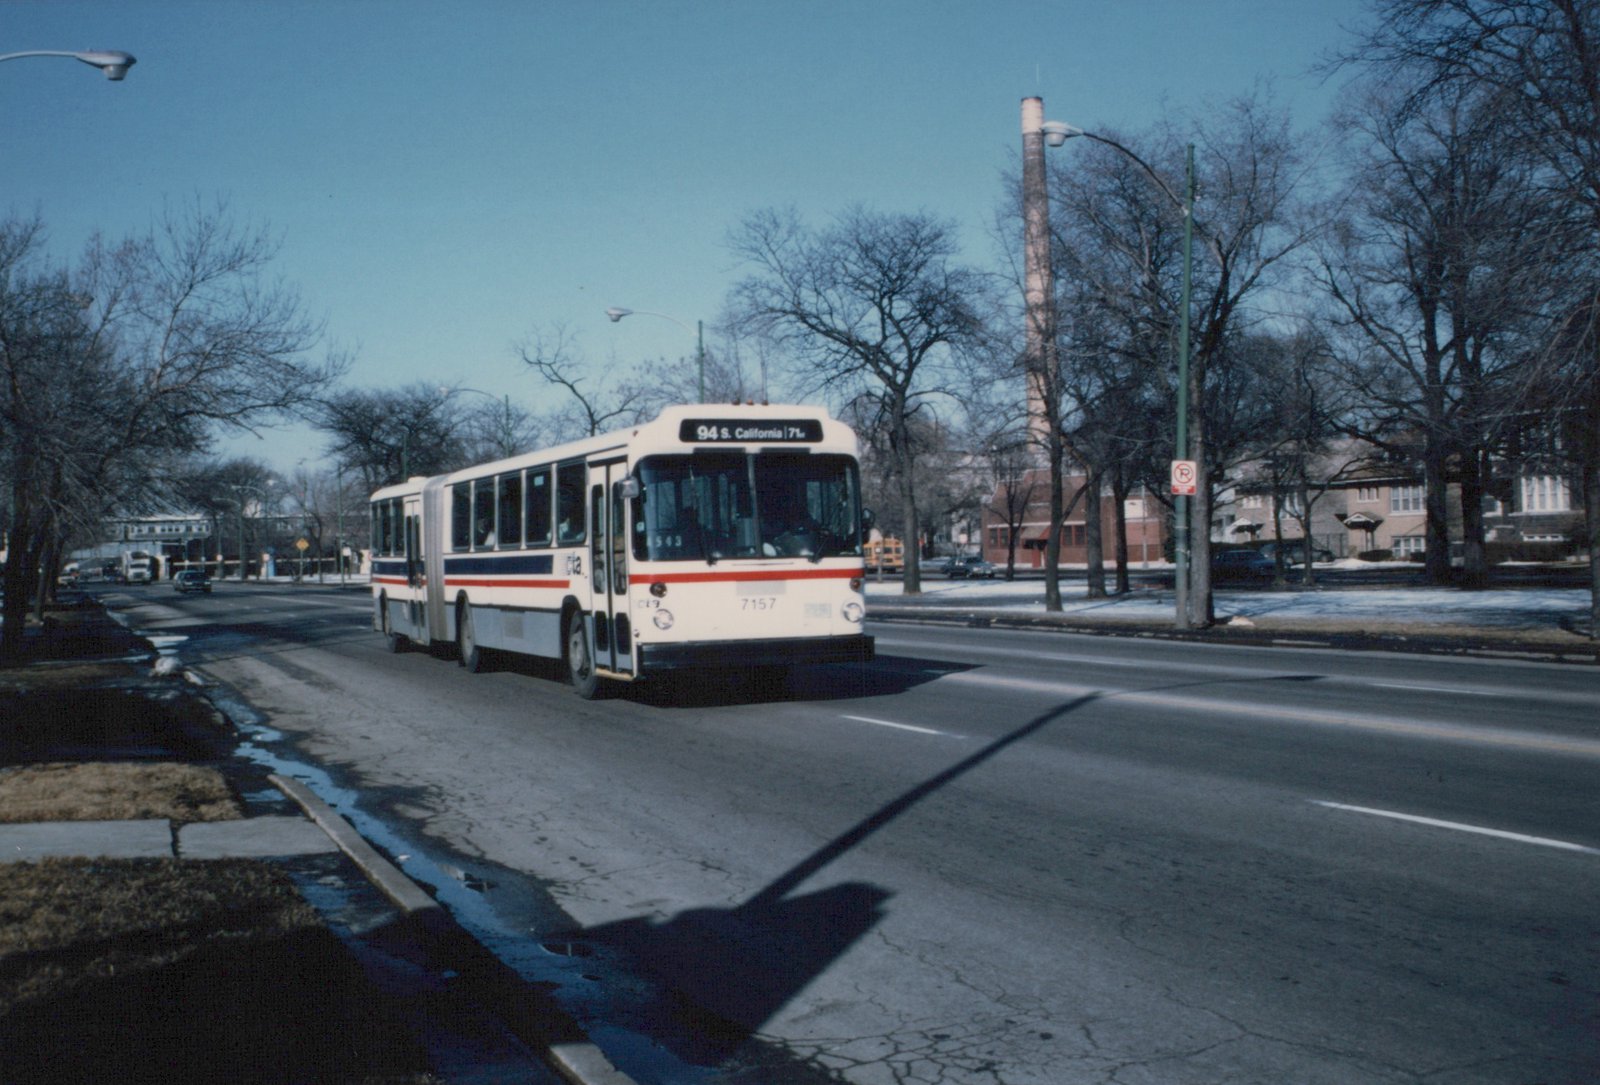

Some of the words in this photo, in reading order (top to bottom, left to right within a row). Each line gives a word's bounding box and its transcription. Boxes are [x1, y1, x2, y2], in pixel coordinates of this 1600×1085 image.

[696, 425, 719, 440] 94
[735, 427, 783, 439] California
[740, 597, 777, 611] 7157
